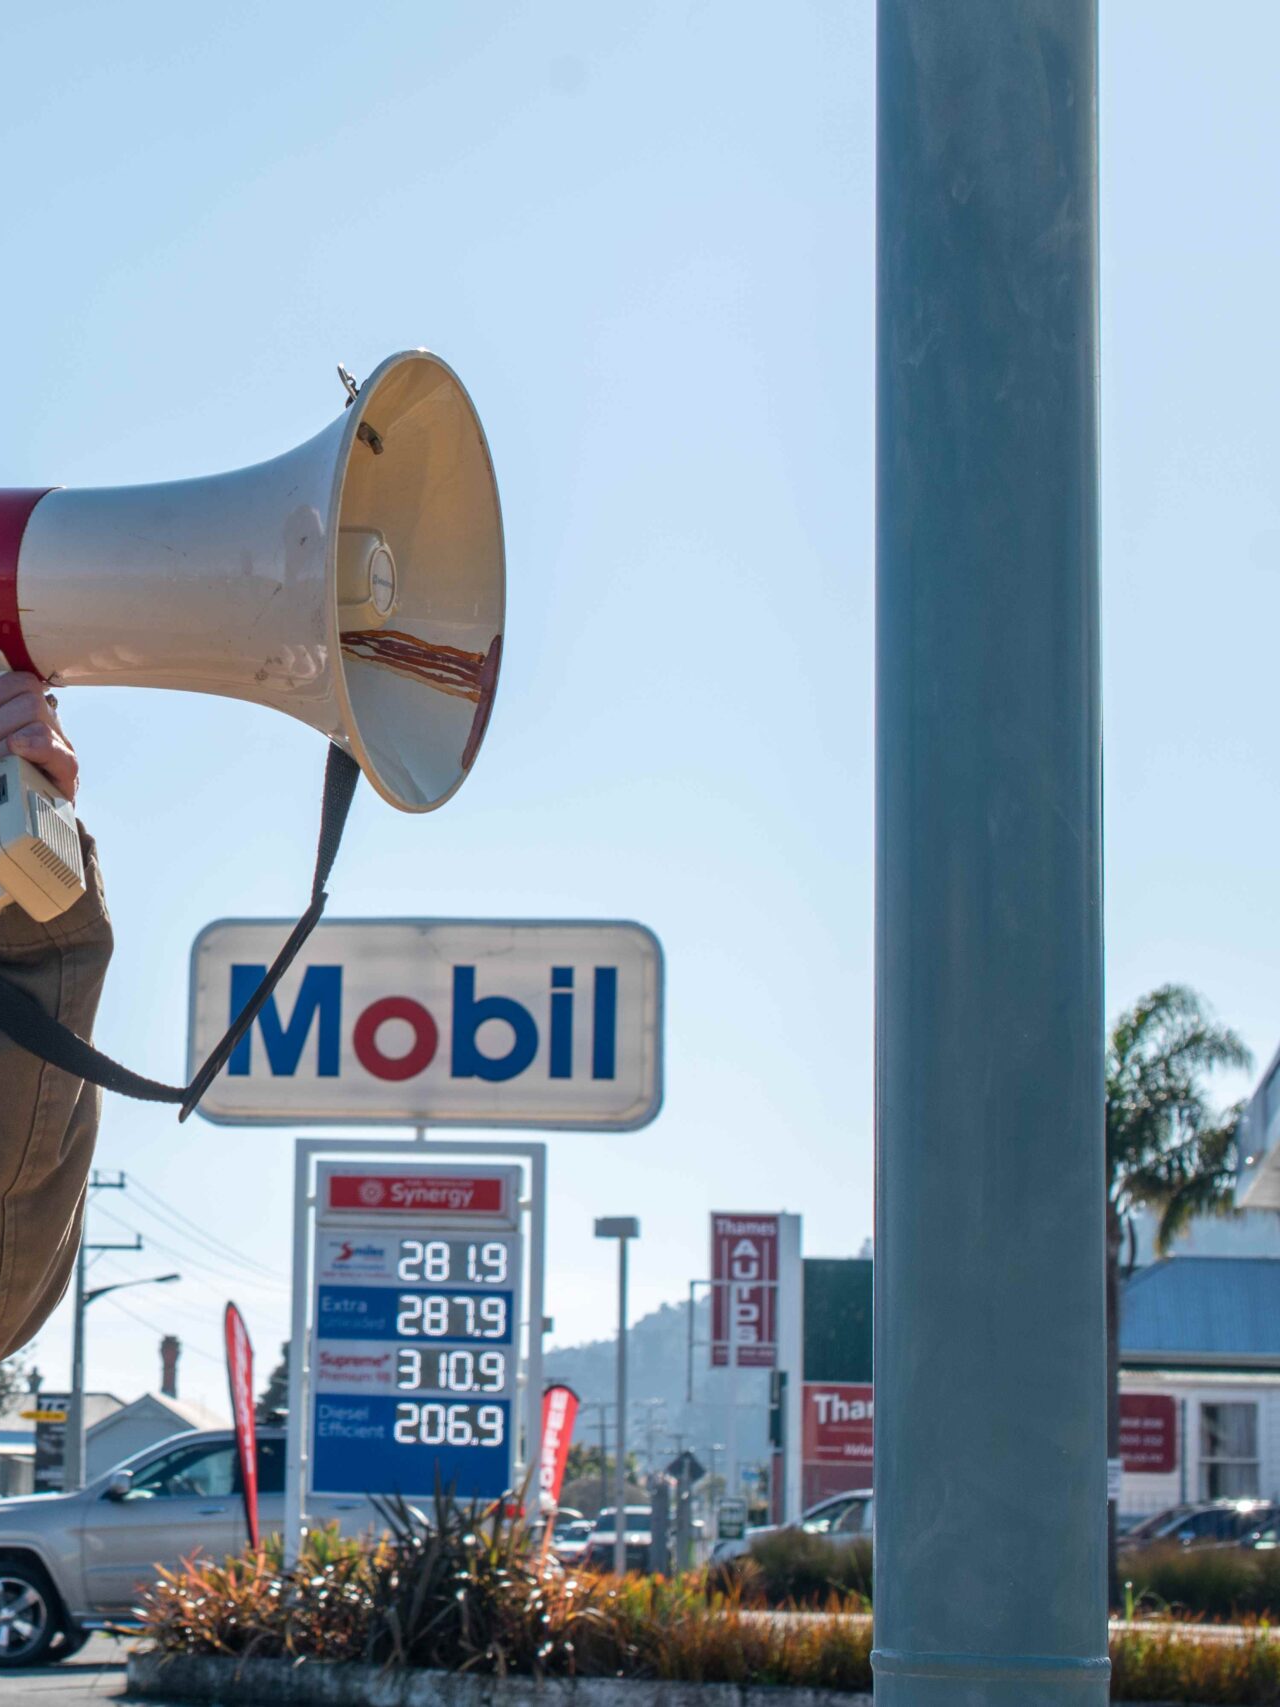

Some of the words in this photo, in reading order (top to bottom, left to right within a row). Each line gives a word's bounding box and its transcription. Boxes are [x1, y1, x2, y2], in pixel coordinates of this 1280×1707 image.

[227, 963, 619, 1083] Mobil
[390, 1182, 475, 1209] Synergy
[716, 1218, 776, 1236] Thames
[397, 1239, 508, 1284] 281.9
[321, 1296, 368, 1313] Extra
[396, 1293, 507, 1339] 287.9
[397, 1348, 506, 1393] 310.9
[319, 1421, 385, 1439] Efficient
[320, 1404, 370, 1420] Diesel
[393, 1401, 504, 1447] 206.9
